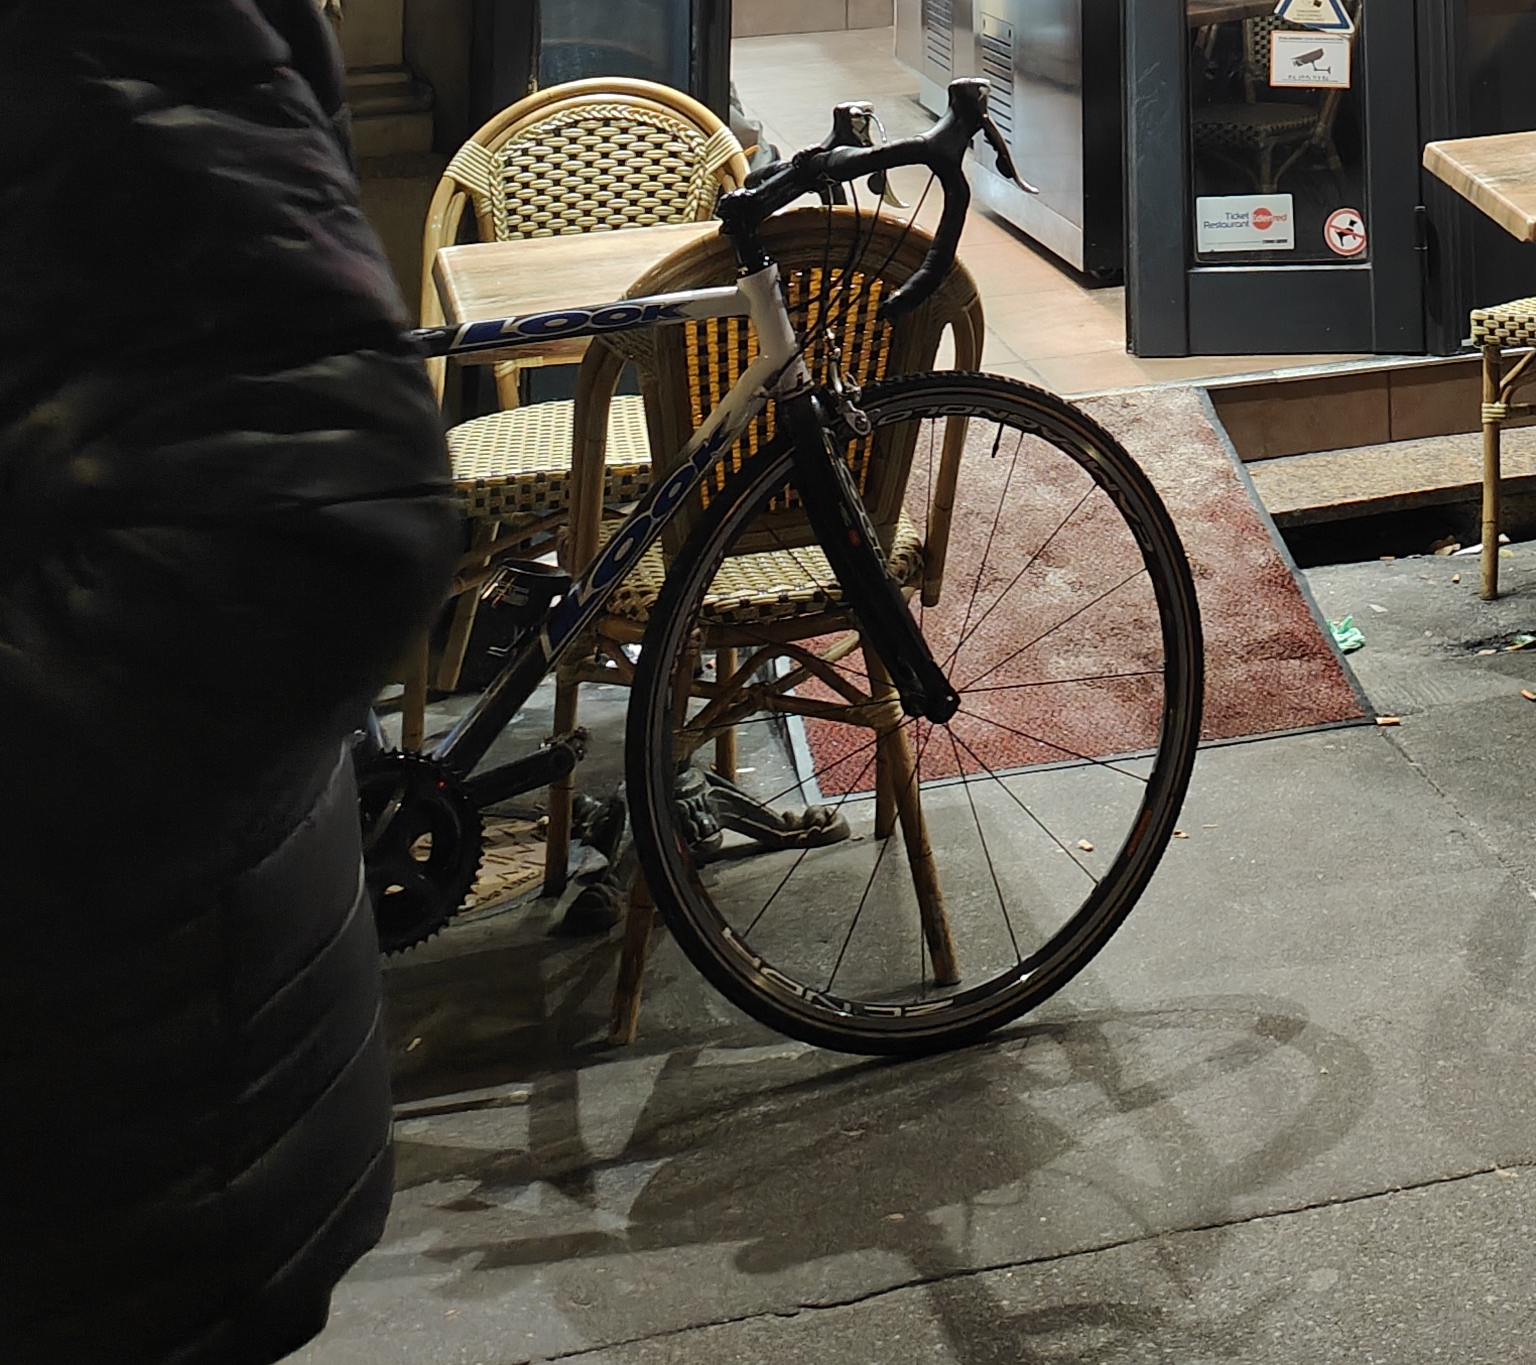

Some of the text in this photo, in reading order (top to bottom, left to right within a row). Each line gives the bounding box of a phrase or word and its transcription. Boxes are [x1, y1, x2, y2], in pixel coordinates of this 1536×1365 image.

[1203, 220, 1250, 229] Restaurant
[452, 299, 695, 347] LOOK
[541, 412, 732, 661] LOOK
